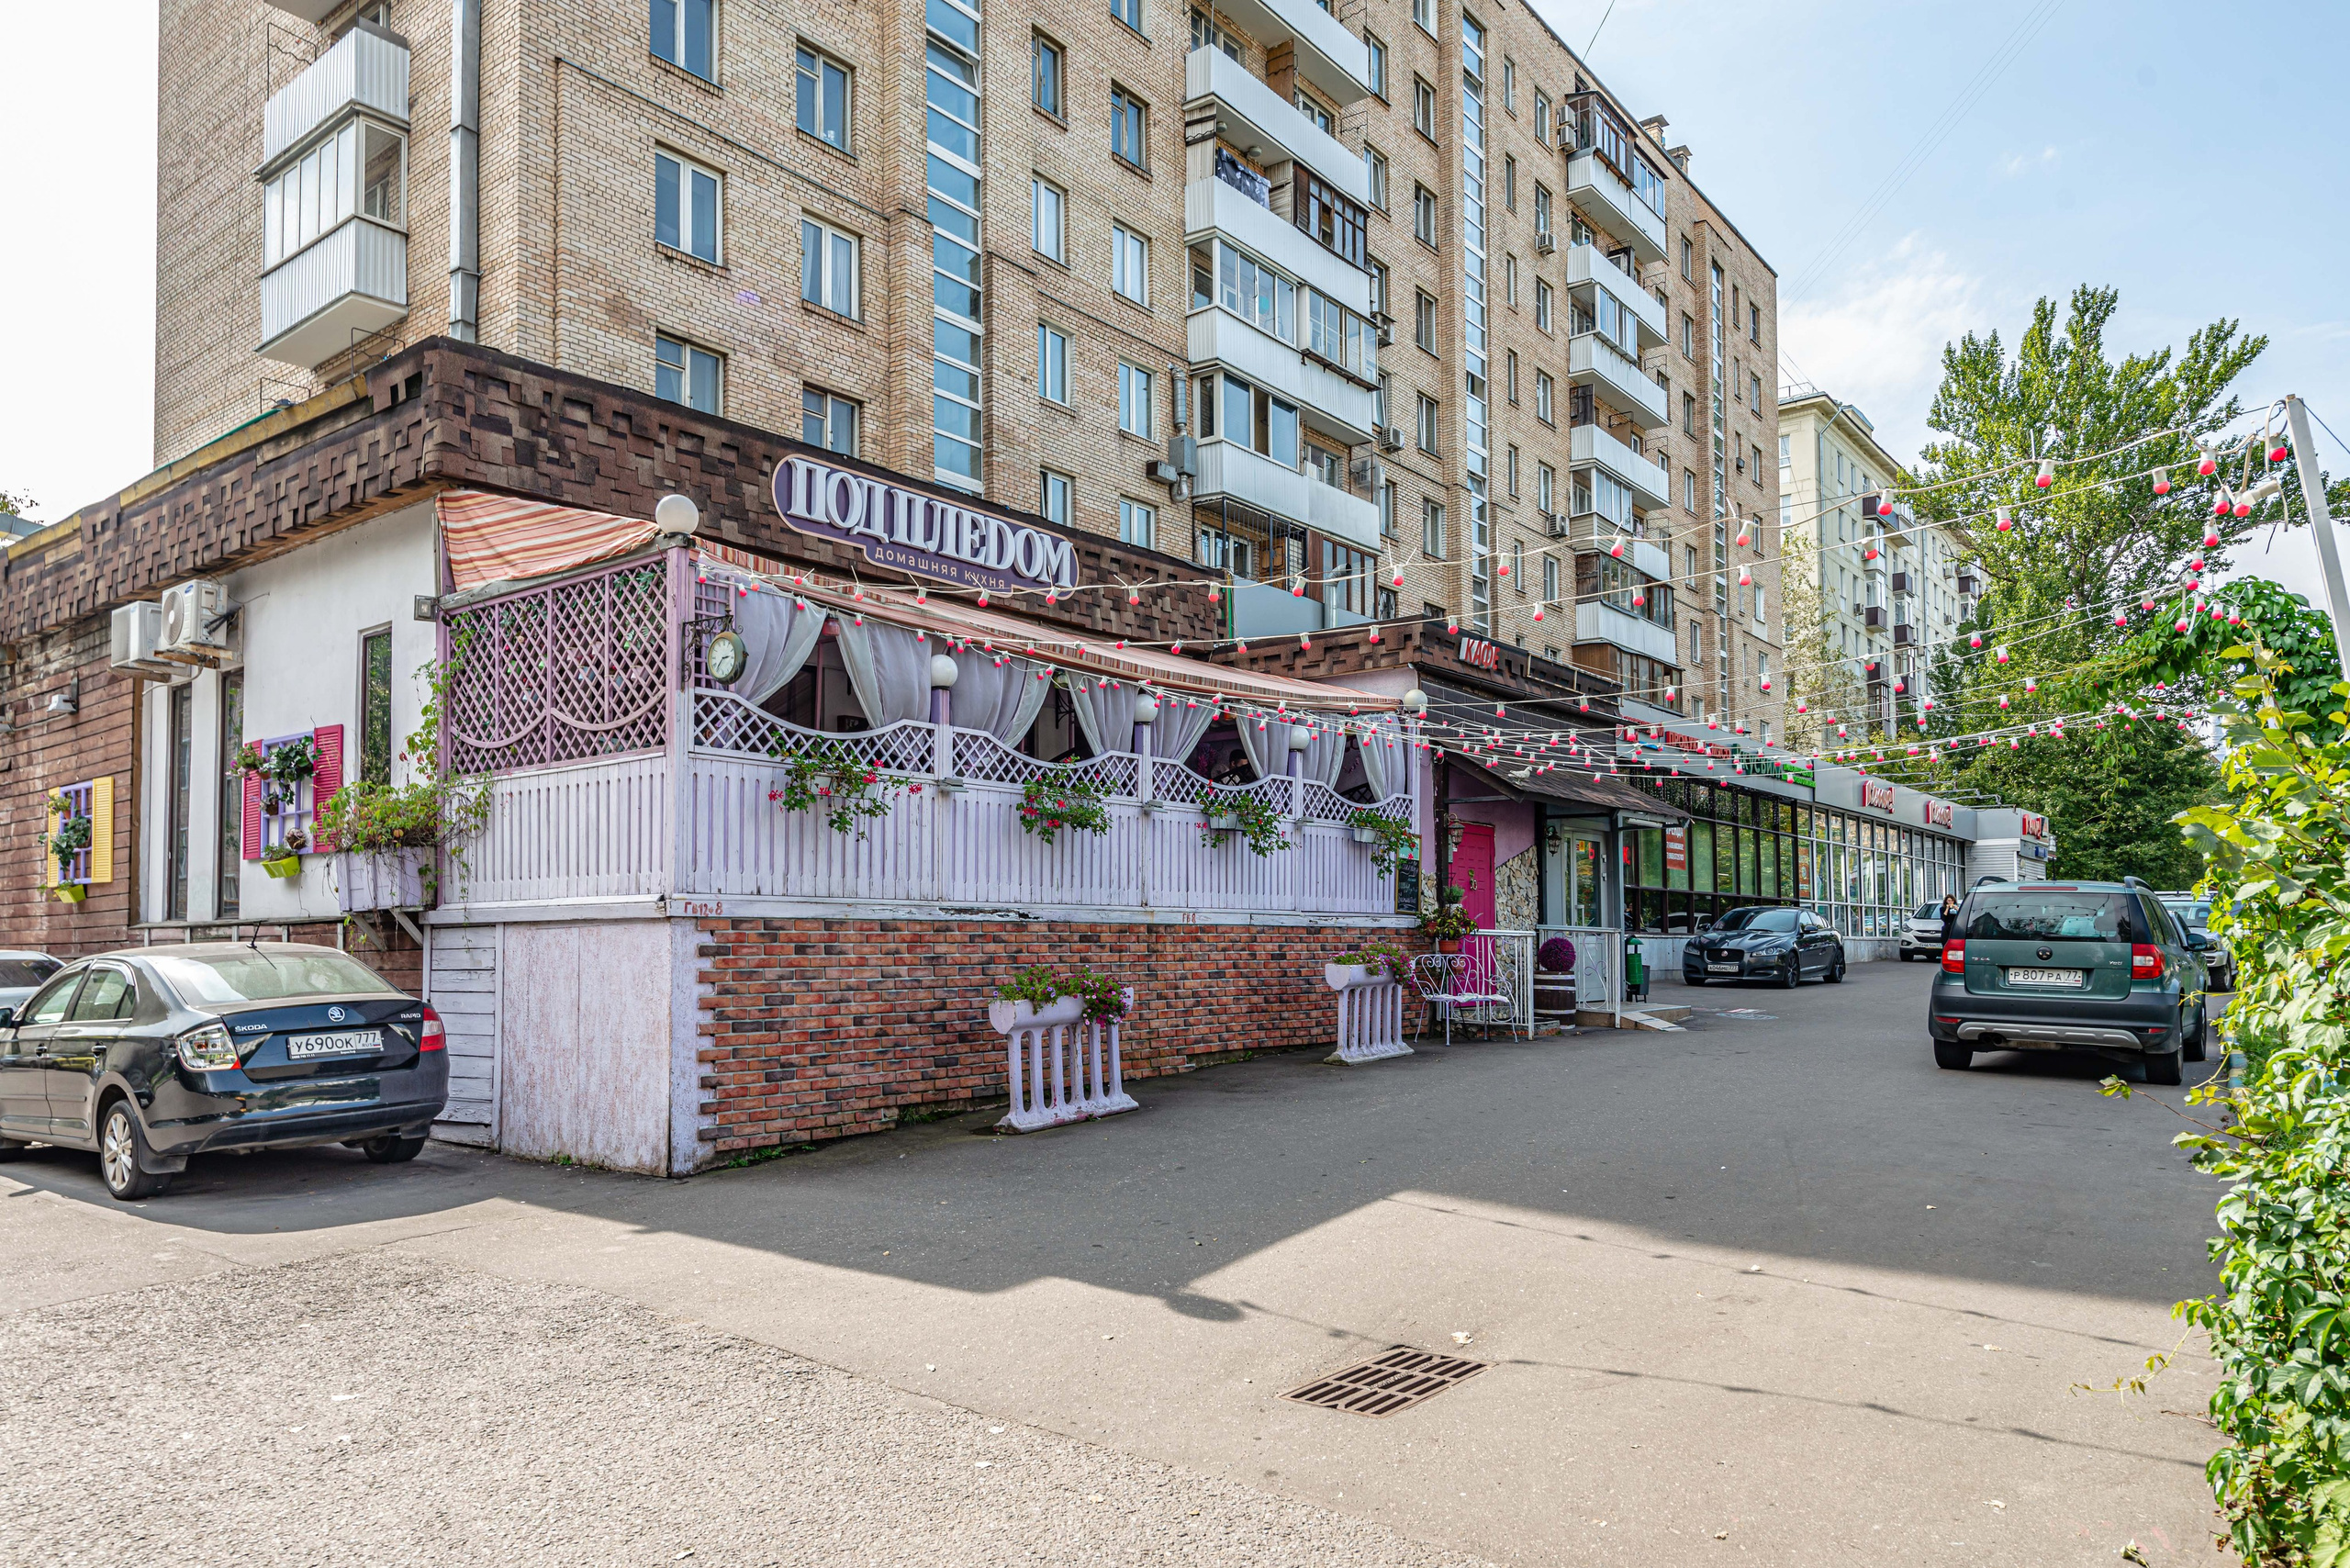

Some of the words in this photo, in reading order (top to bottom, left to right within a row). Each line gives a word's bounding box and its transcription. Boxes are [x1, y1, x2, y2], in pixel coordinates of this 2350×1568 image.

[1464, 637, 1501, 670] КАФЕ
[2065, 970, 2078, 980] 77
[295, 1036, 354, 1052] У690ОК
[355, 1032, 377, 1044] 777
